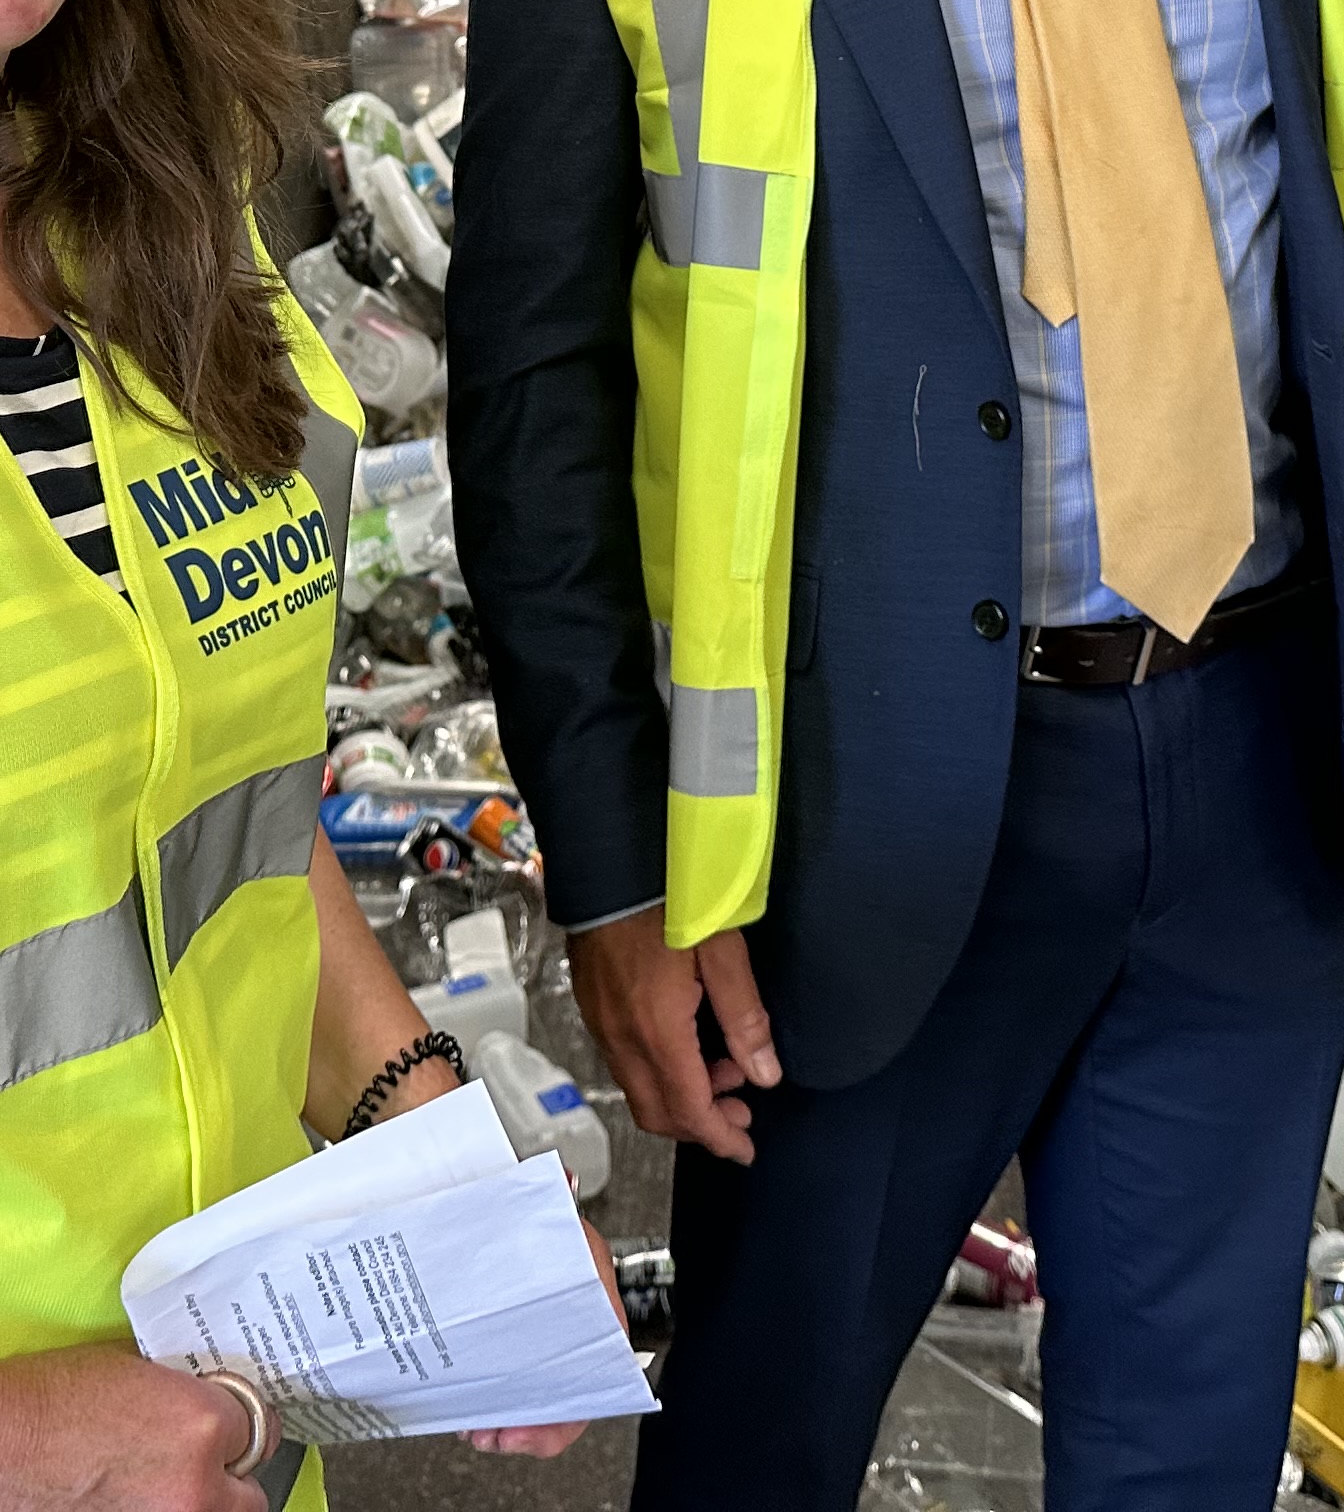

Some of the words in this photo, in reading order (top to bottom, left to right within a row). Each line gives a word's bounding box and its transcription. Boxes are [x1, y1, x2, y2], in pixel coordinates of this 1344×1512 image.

[127, 454, 258, 547] Mid
[164, 509, 331, 625] Devon
[198, 601, 281, 656] DISTRICT
[284, 571, 337, 615] COUNCIL
[303, 1250, 323, 1282] editor:
[359, 1237, 379, 1270] Council
[315, 1281, 327, 1291] to
[360, 1277, 380, 1306] please
[371, 1268, 390, 1297] District
[319, 1290, 337, 1317] Notes
[382, 1296, 400, 1322] Devon
[396, 1293, 421, 1336] Telephone:
[346, 1318, 366, 1351] Feature
[371, 1304, 396, 1350] information
[391, 1321, 406, 1337] Mid
